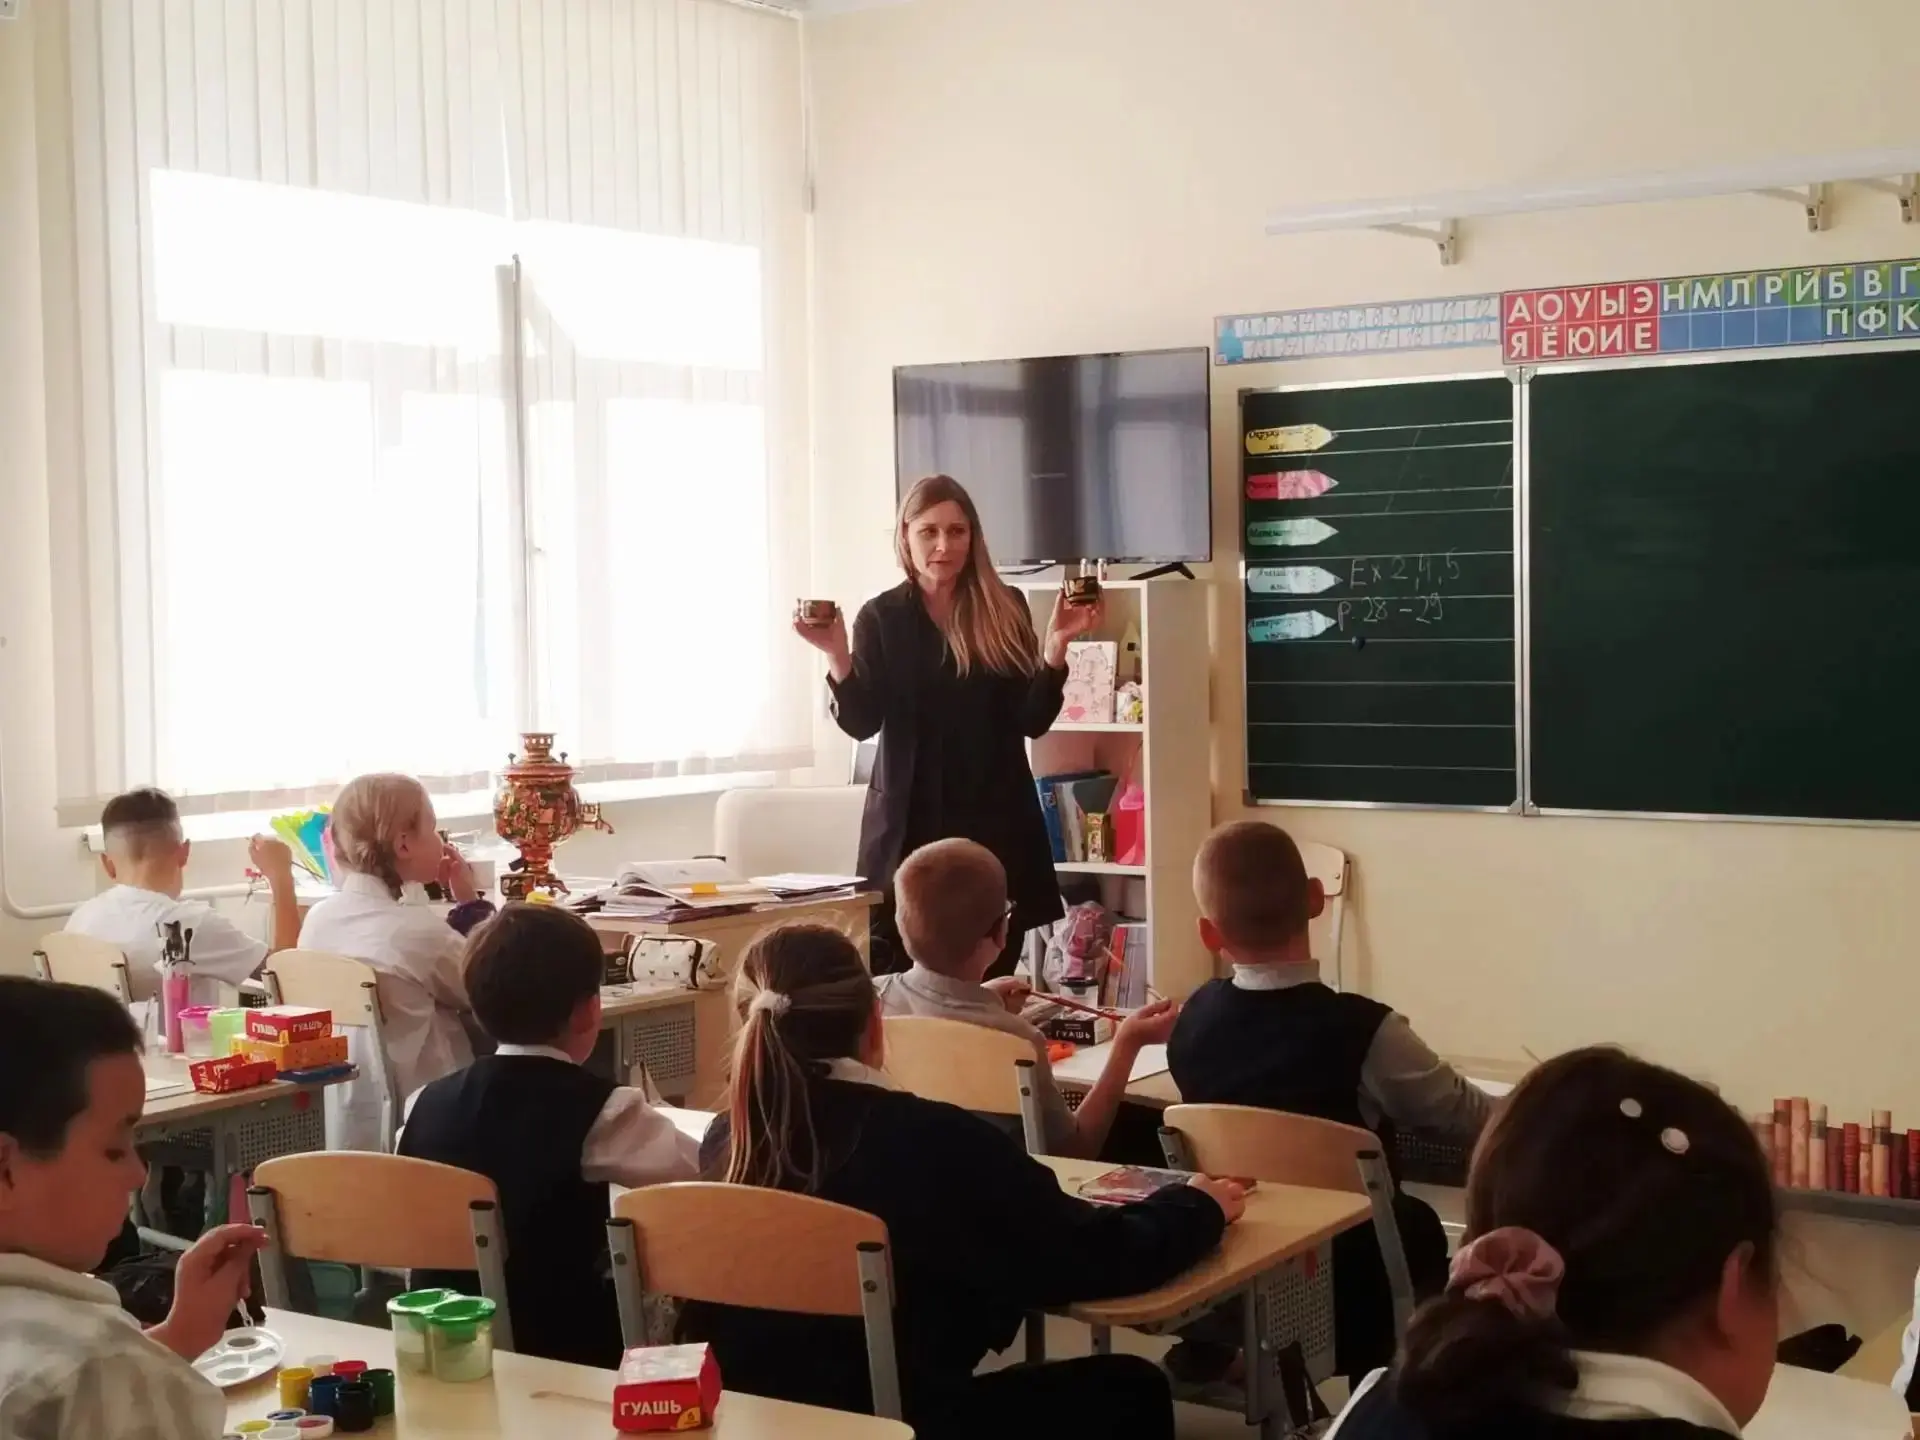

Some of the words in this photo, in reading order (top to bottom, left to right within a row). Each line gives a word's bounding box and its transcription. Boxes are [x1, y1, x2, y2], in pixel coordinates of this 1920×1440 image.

[252, 1022, 279, 1036] ГУАШЬ
[293, 1021, 323, 1033] ГУАШЬ
[1056, 1030, 1092, 1039] ГУАШЬ
[620, 1400, 682, 1416] ГУАШЬ
